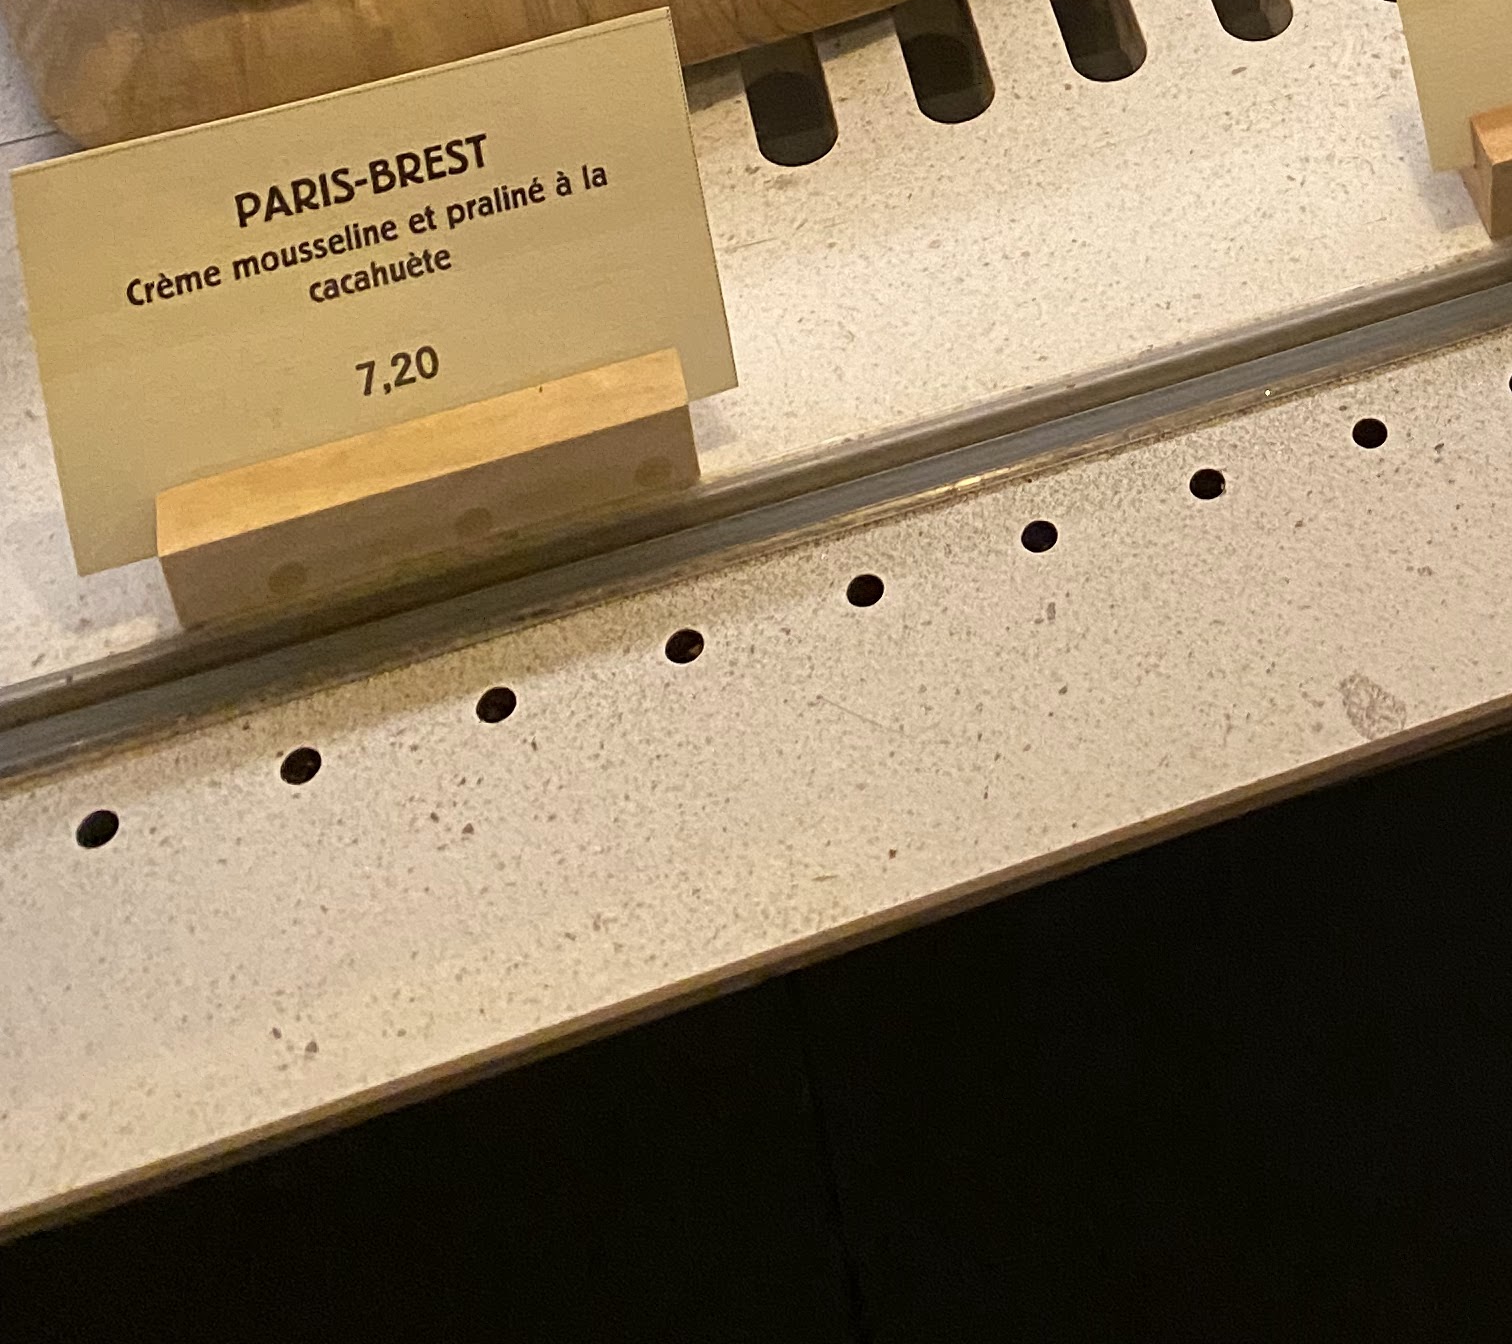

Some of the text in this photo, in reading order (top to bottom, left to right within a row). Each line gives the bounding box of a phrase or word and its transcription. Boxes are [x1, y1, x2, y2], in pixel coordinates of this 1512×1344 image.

[235, 134, 488, 227] PARIS-BREST
[127, 165, 607, 305] Crème mousseline et praliné à la
[309, 249, 451, 303] cacahuète
[356, 346, 439, 396] 7,20
